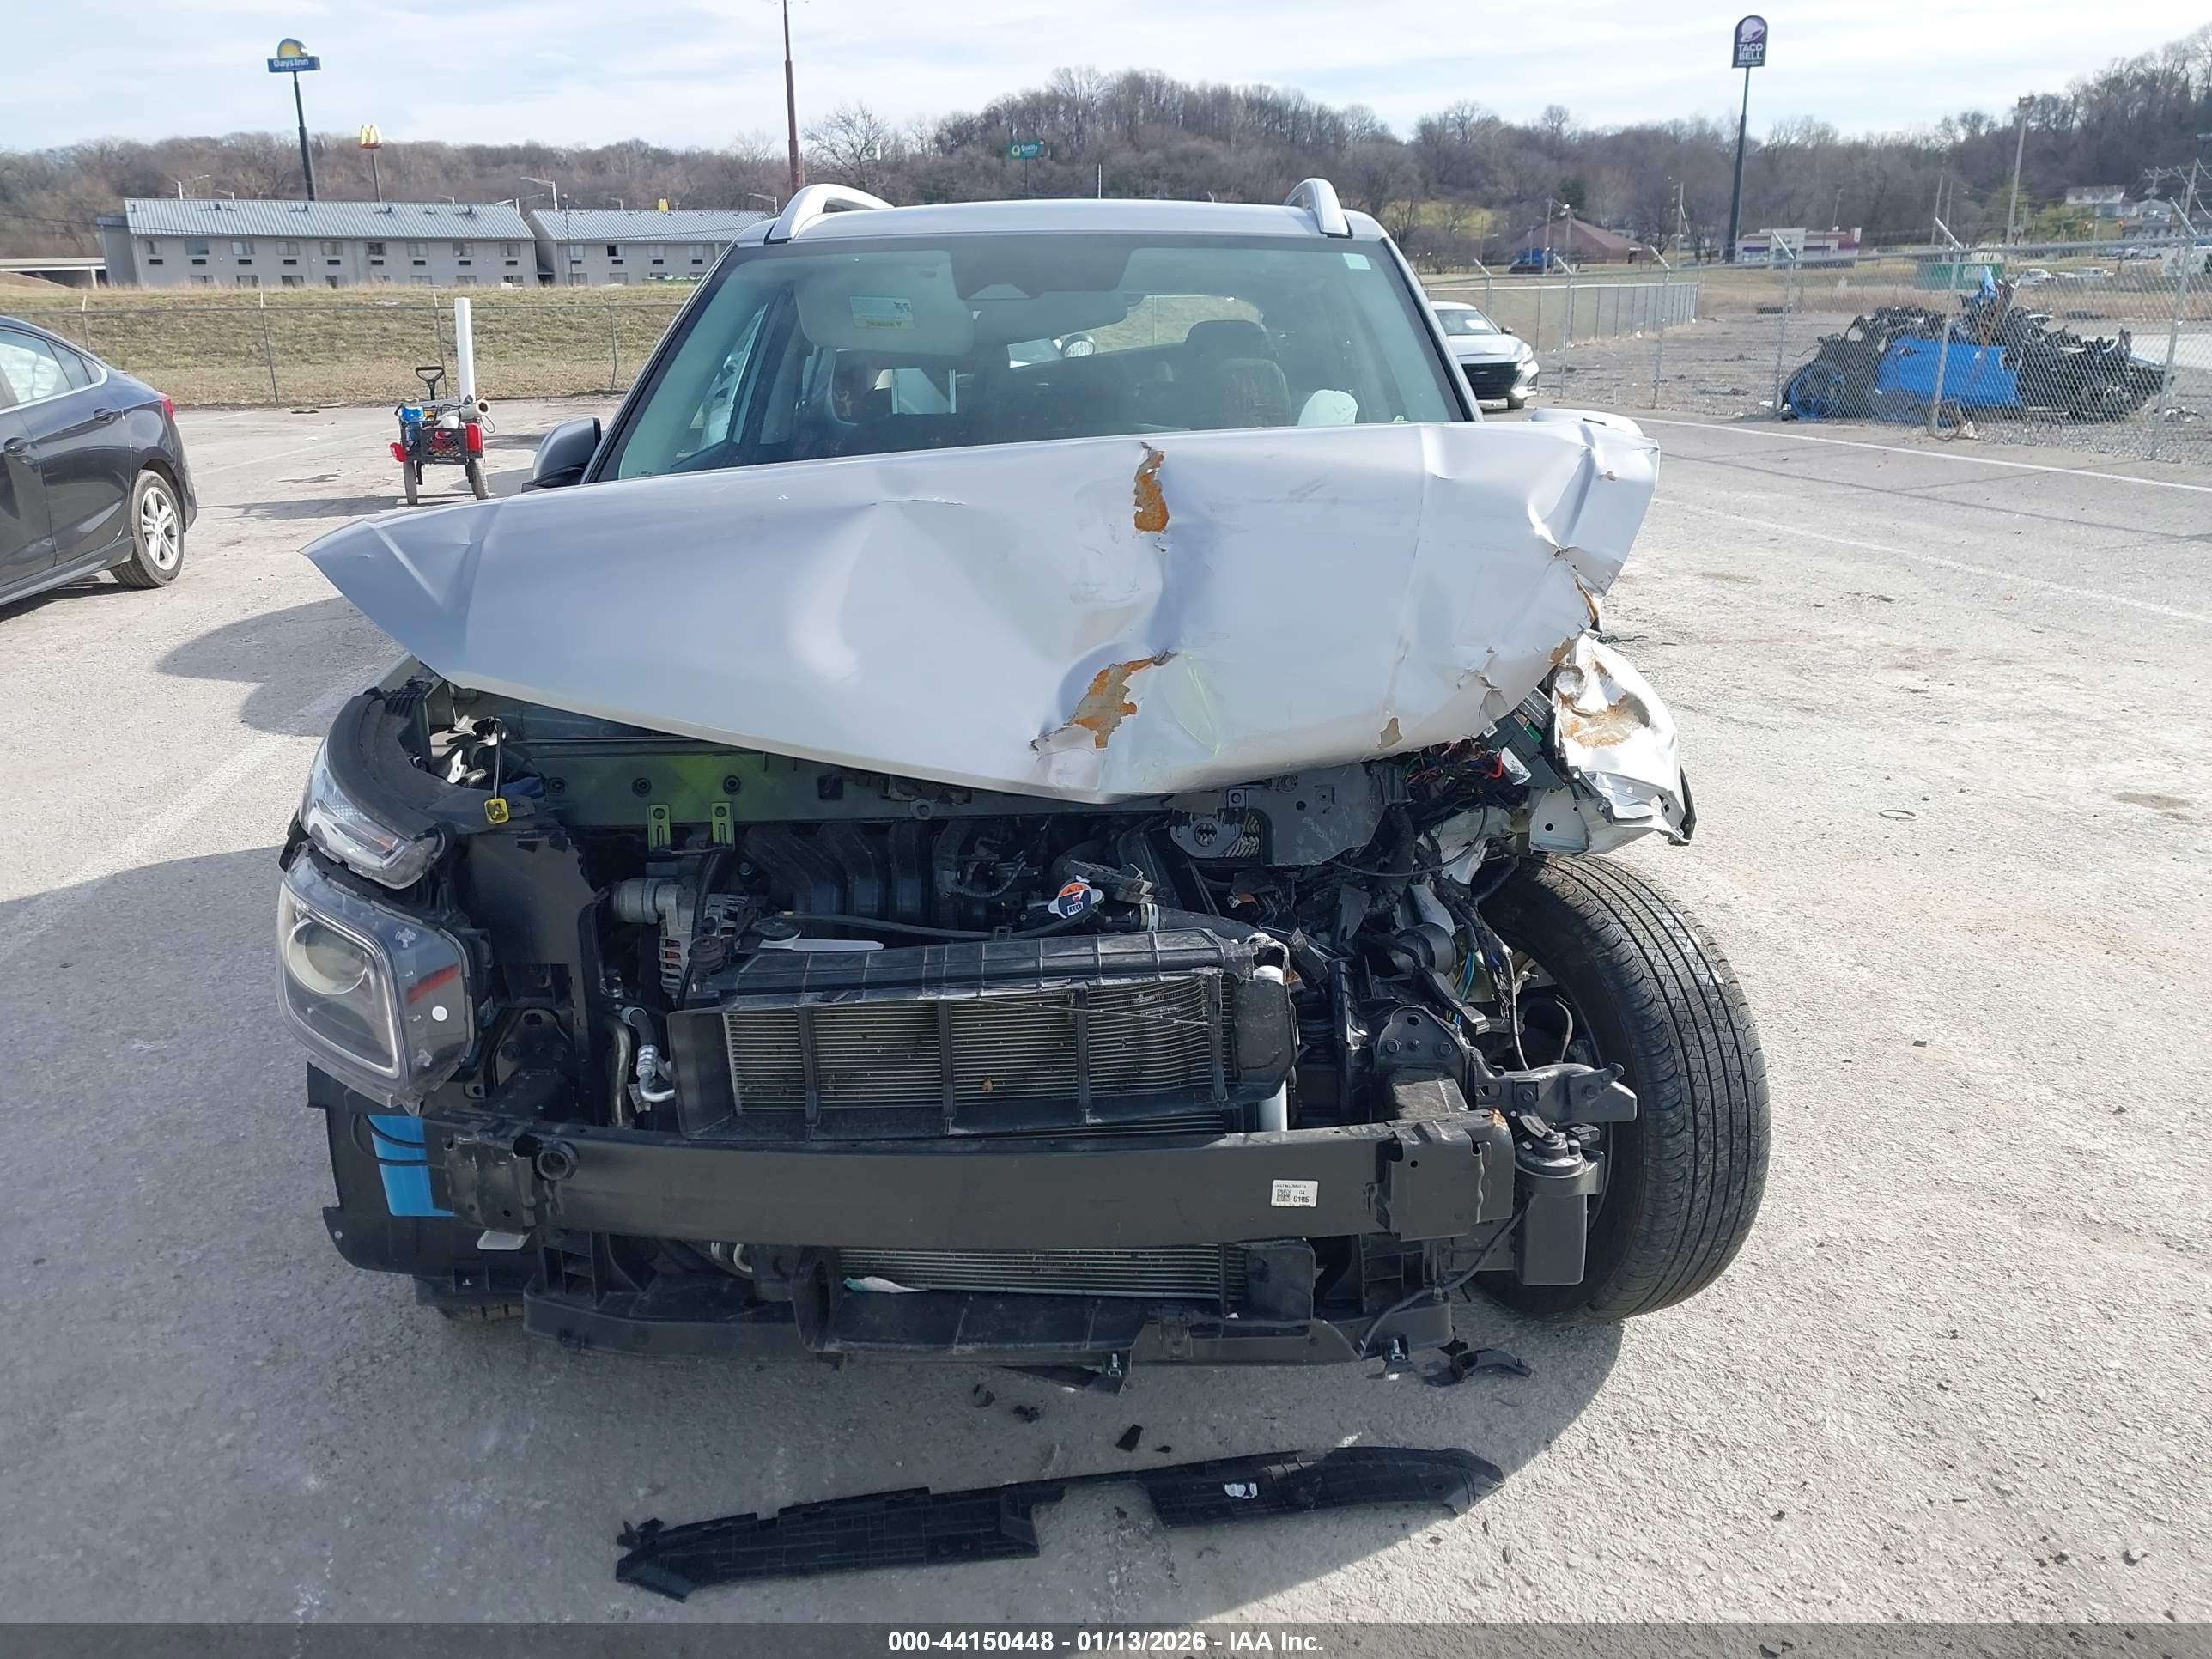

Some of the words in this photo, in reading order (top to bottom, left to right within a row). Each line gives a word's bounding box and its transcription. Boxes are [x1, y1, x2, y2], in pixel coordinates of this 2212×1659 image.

[1737, 43, 1764, 52] TACO
[1738, 52, 1762, 60] BELL
[273, 59, 295, 69] Days
